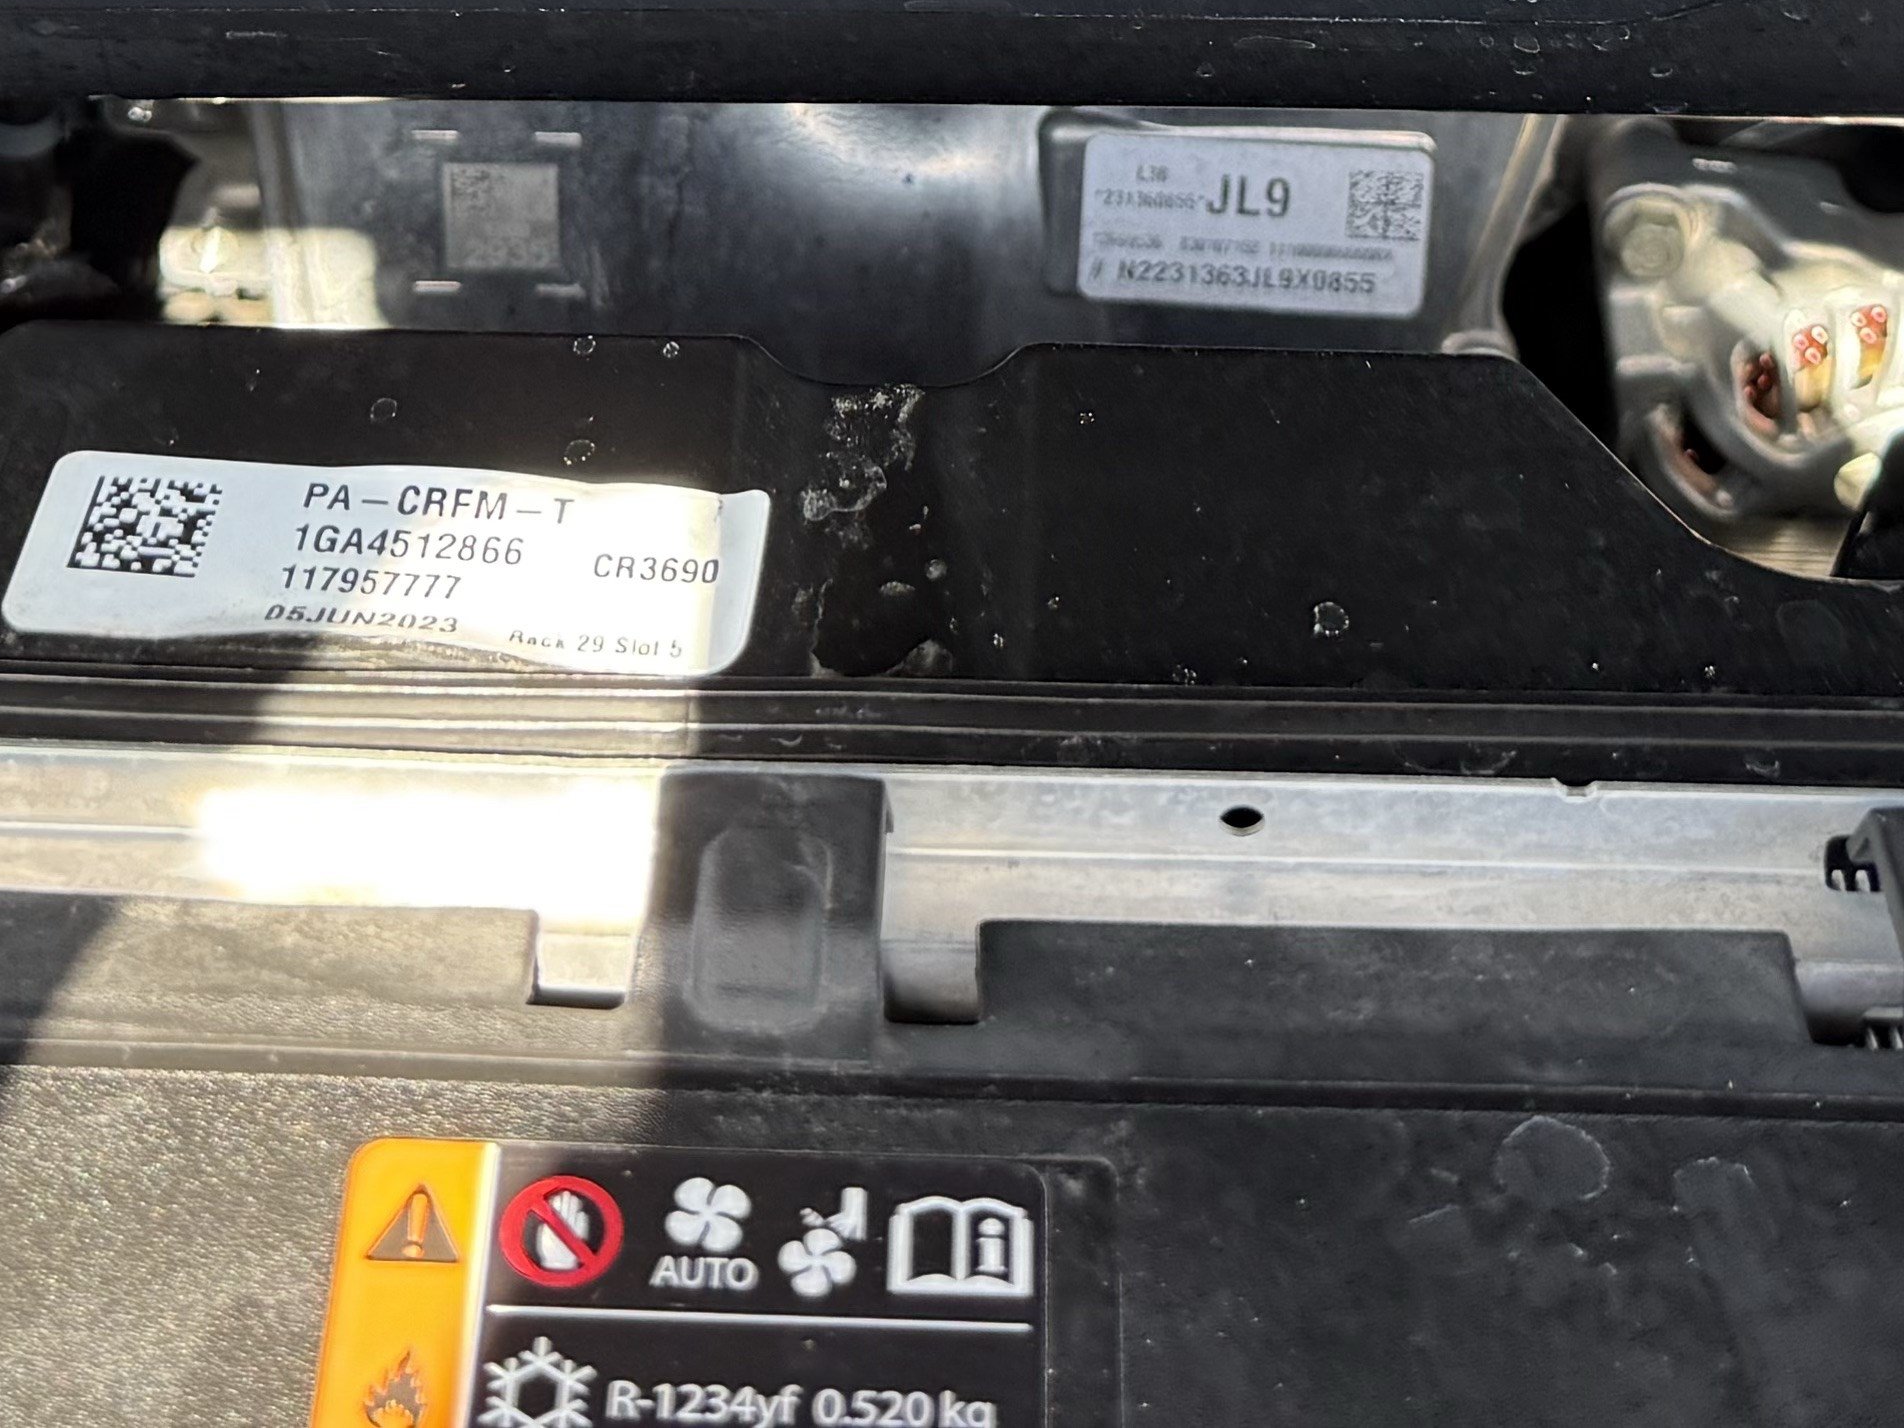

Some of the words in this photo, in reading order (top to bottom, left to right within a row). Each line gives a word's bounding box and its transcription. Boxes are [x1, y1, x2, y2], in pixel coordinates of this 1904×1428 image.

[1207, 174, 1291, 217] JL9
[294, 525, 524, 565] 1GA4512866
[281, 565, 462, 599] 117957777
[593, 554, 719, 585] CR3690
[264, 605, 458, 633] 05JUN2023
[577, 634, 604, 652] 29
[615, 636, 658, 656] Slot
[651, 1256, 757, 1290] AUTO
[605, 1378, 803, 1428] R-1234yf
[812, 1388, 935, 1427] 0.520
